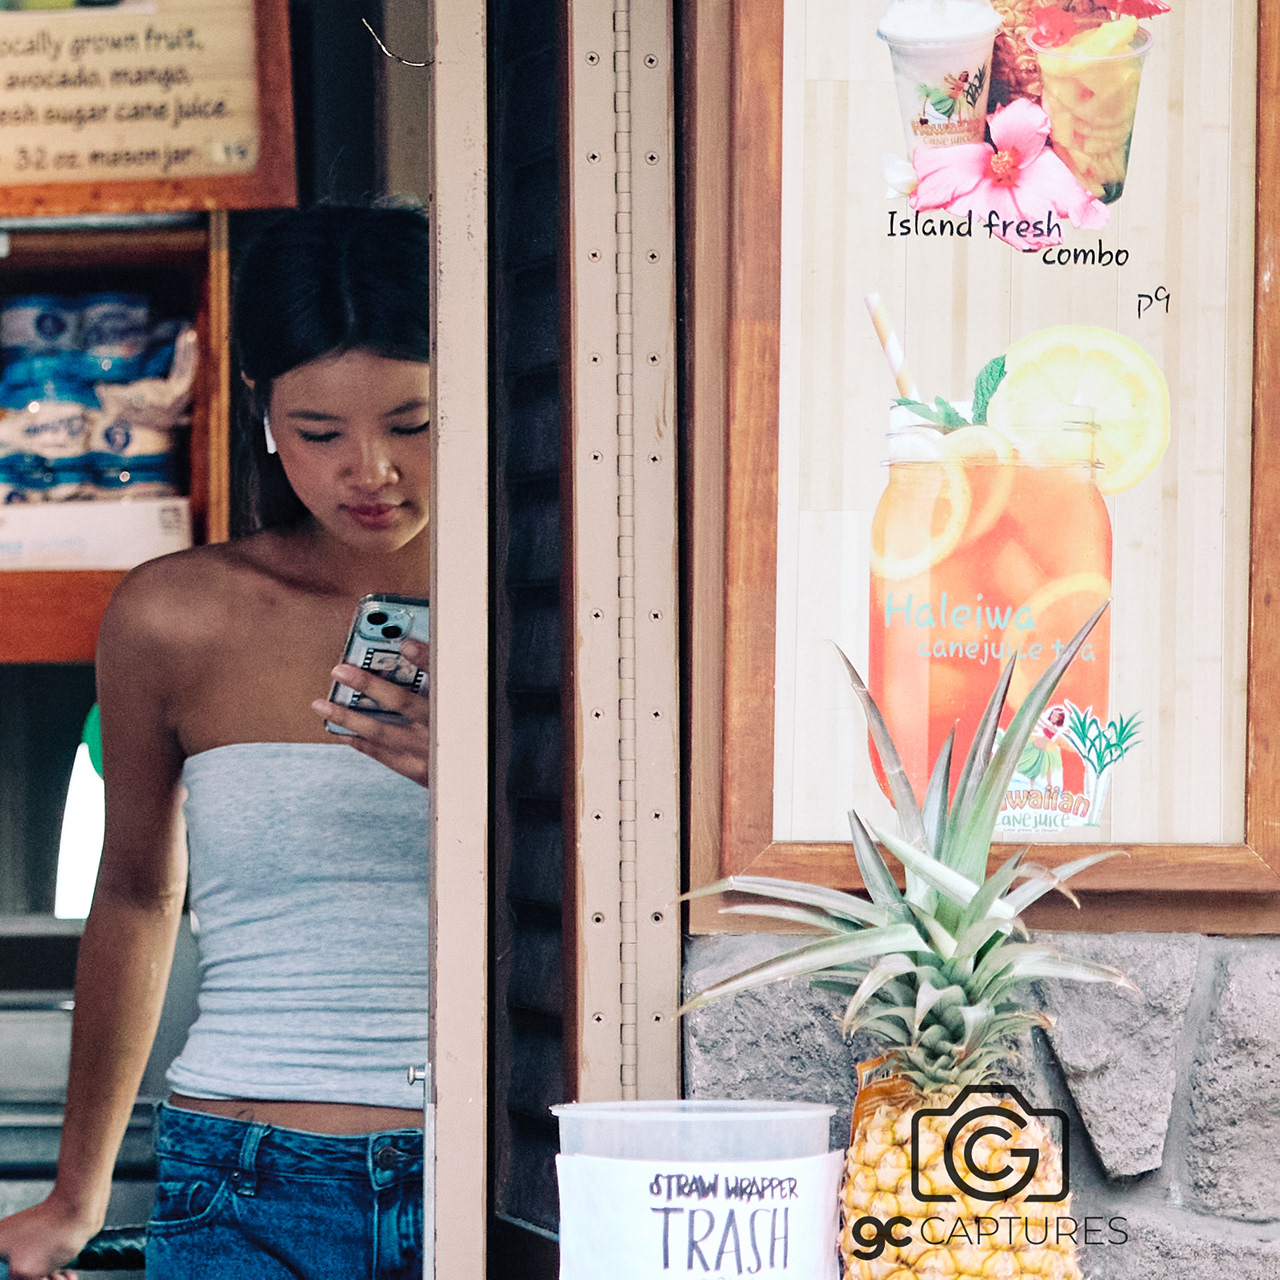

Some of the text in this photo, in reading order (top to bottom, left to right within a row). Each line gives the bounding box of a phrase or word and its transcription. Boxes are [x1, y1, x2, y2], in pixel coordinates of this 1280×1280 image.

[887, 210, 1062, 238] Island fresh
[1042, 239, 1130, 267] combo
[1138, 286, 1171, 319] p9
[885, 592, 1036, 631] Haleiwa
[1051, 639, 1096, 661] ta
[649, 1173, 800, 1204] STRAW WRAPPER
[650, 1206, 790, 1276] TRASH
